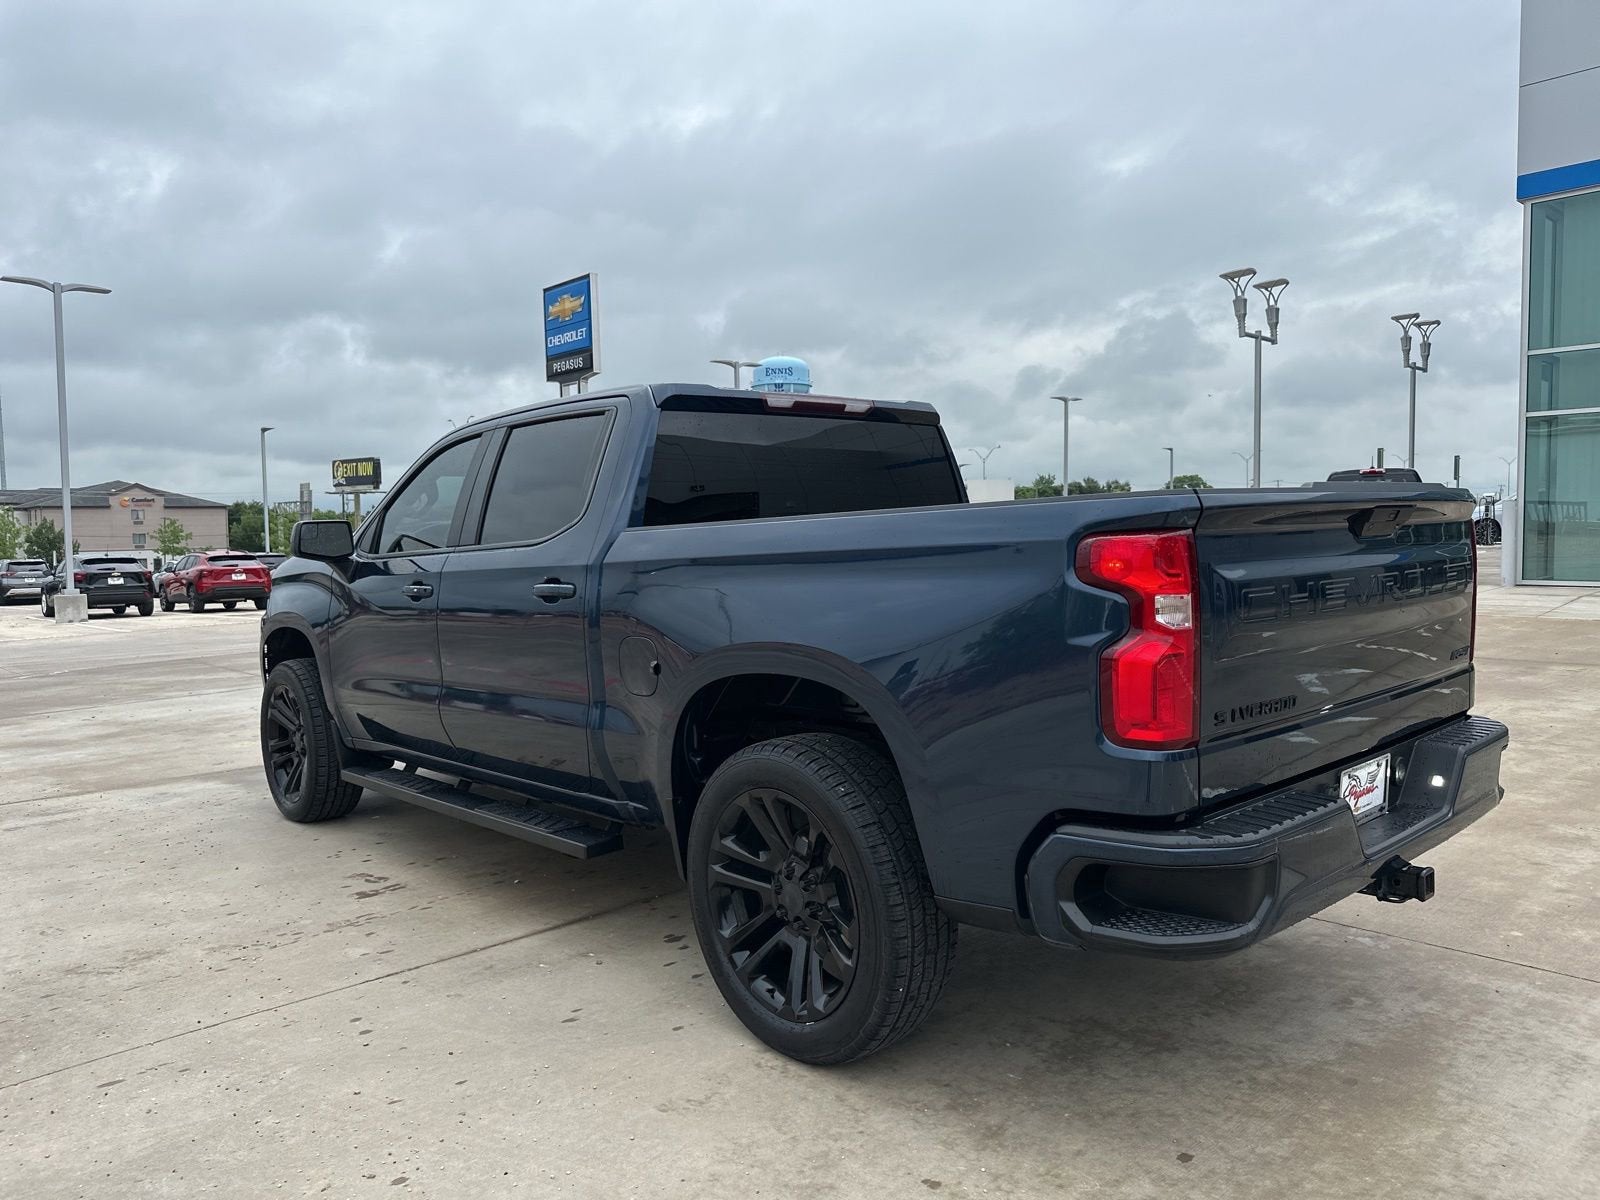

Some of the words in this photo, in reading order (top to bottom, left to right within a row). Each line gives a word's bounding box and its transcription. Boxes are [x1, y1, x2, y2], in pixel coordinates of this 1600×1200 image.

[547, 327, 587, 348] CHEVROLET
[552, 357, 584, 374] PEGASUS
[765, 366, 794, 377] ENNIS
[343, 462, 357, 477] EXIT
[357, 461, 374, 476] NOW
[1239, 562, 1471, 623] CHEVROLET
